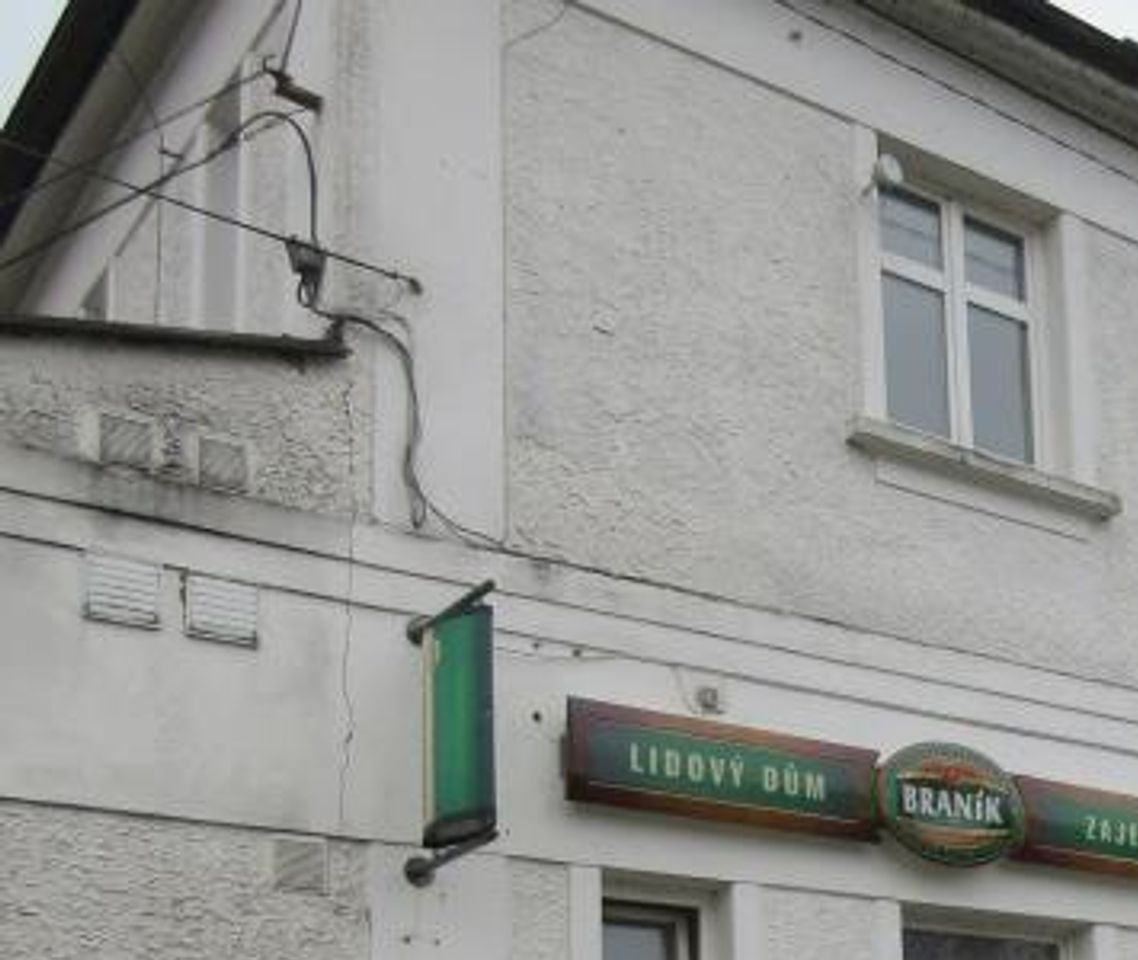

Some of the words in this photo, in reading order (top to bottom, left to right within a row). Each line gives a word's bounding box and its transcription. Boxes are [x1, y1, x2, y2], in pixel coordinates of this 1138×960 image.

[629, 742, 744, 788] LIDOVÝ
[764, 762, 825, 801] DŮM
[902, 783, 1004, 824] BRANÍK
